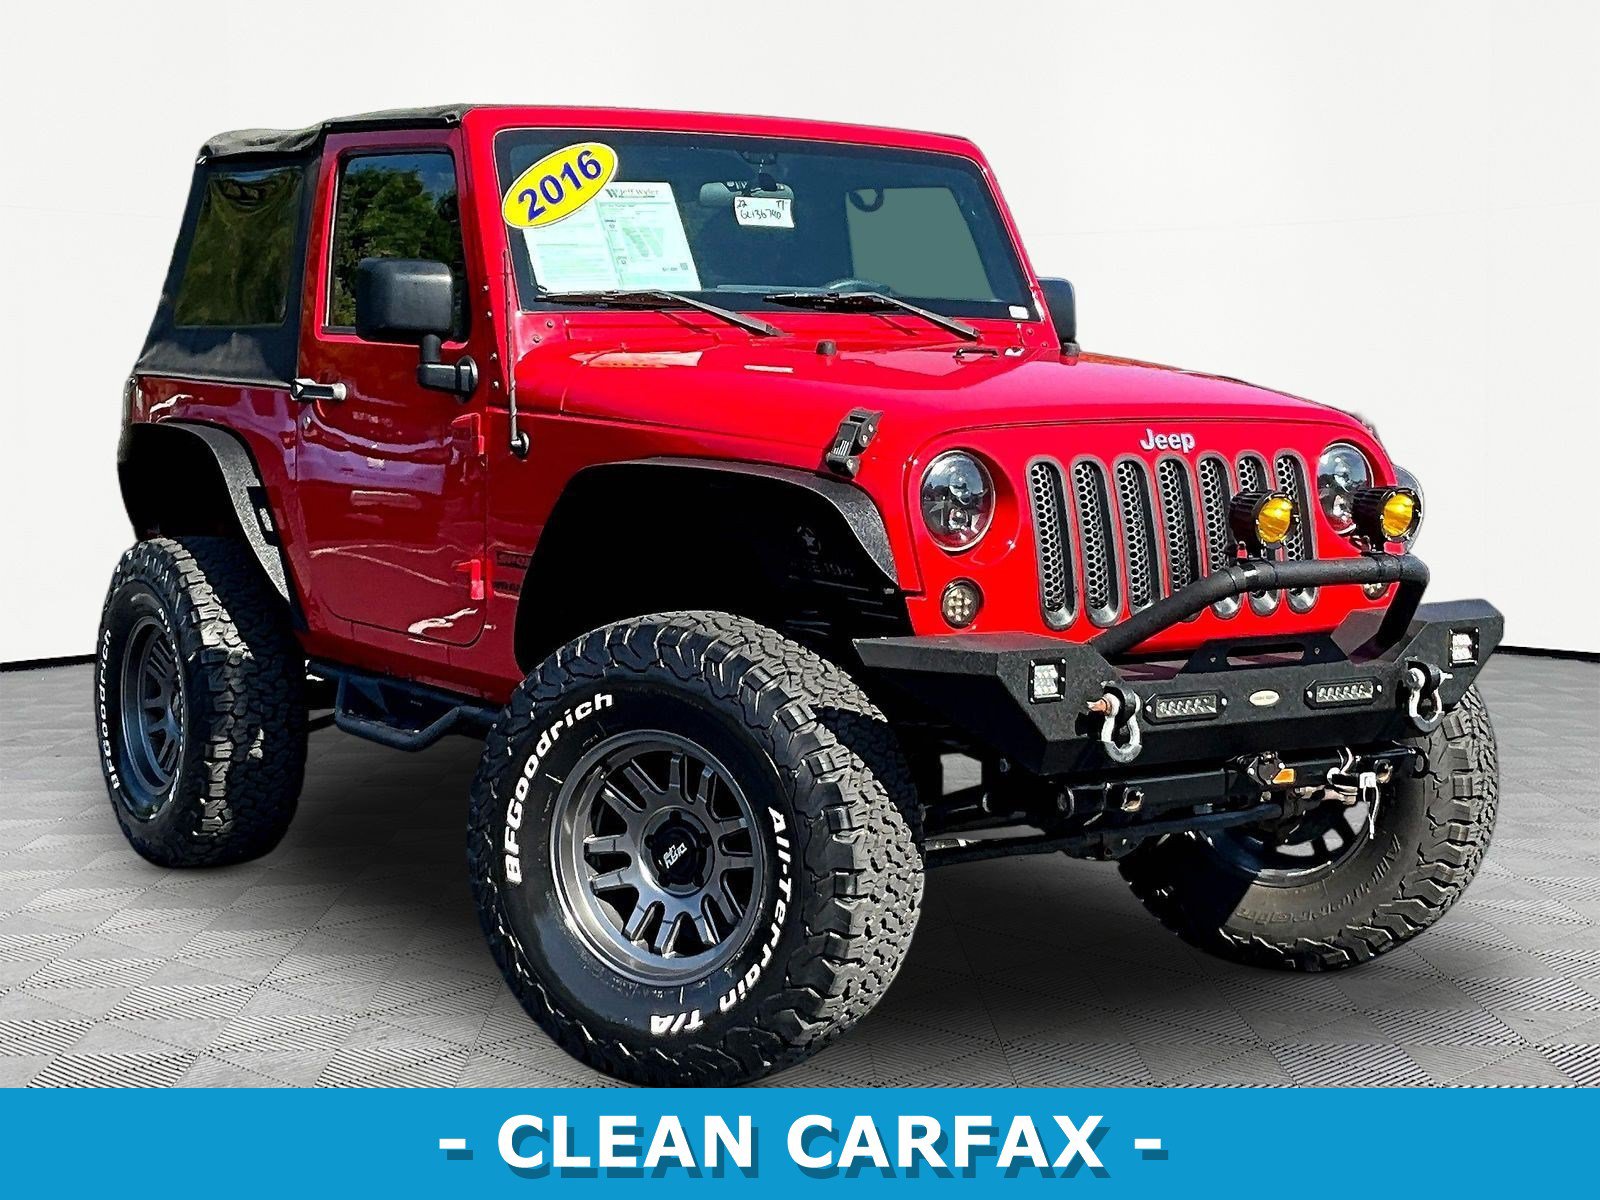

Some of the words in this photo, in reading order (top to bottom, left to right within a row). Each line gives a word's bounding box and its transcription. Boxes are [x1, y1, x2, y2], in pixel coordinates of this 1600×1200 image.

[518, 150, 602, 222] 2016
[1139, 428, 1196, 453] Jeep
[99, 629, 121, 789] BFGoodrich
[504, 693, 615, 885] BFGoodrich
[650, 1009, 704, 1035] T/A
